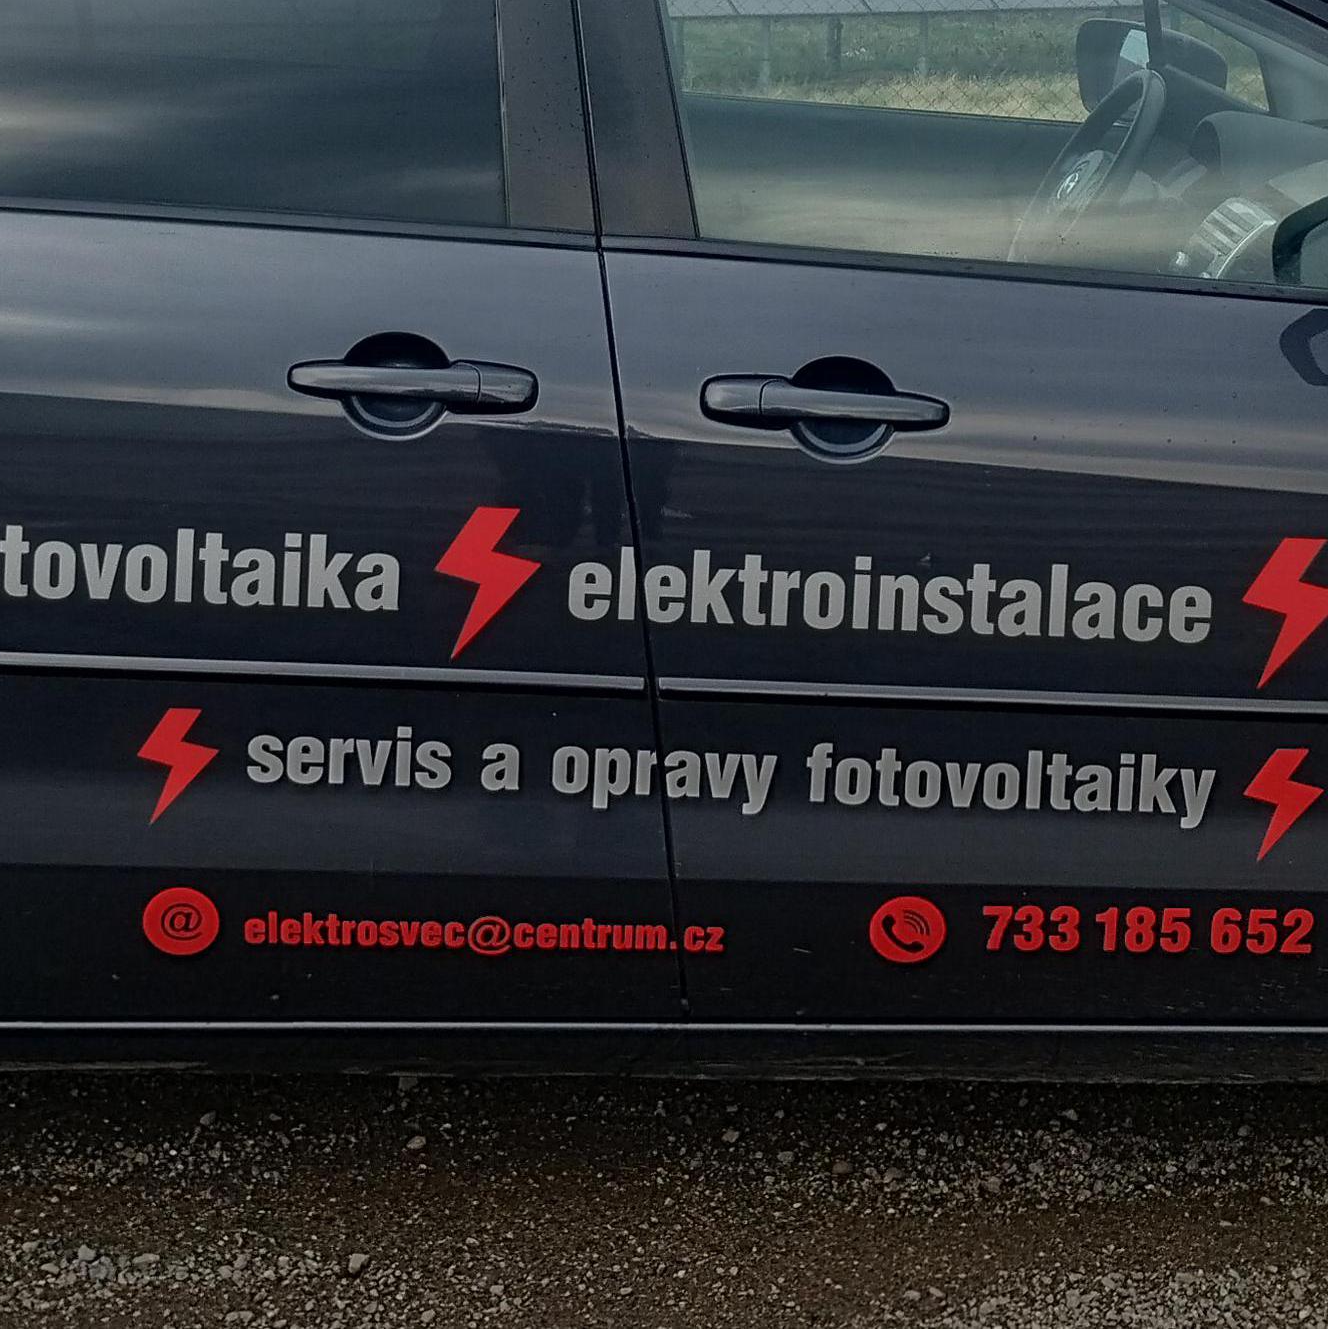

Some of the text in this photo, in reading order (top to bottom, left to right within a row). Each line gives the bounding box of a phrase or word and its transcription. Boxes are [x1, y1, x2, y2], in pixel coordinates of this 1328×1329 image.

[568, 545, 1212, 644] elektroinstalace
[246, 726, 1216, 829] servis a opravy fotovoltaiky
[244, 912, 724, 955] elektrosvec@centrum.cz
[982, 905, 1314, 955] 733 185 652
